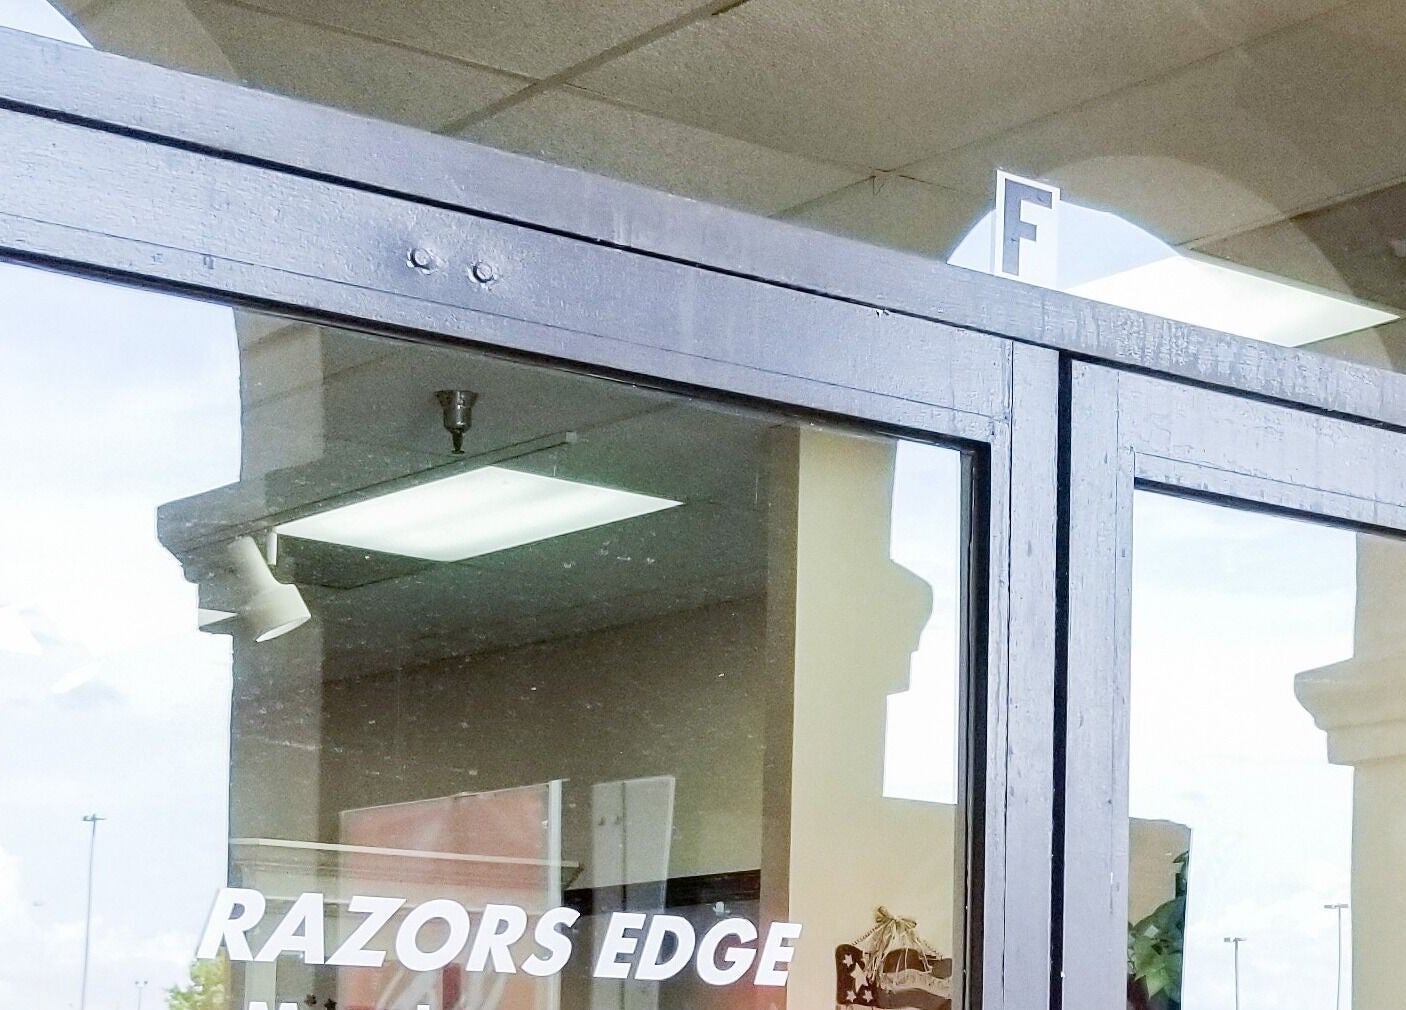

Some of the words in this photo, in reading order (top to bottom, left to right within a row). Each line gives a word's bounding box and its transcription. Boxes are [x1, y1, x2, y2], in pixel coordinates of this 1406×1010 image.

[1002, 178, 1052, 276] F
[196, 887, 580, 977] RAZORS
[592, 911, 803, 987] EDGE
